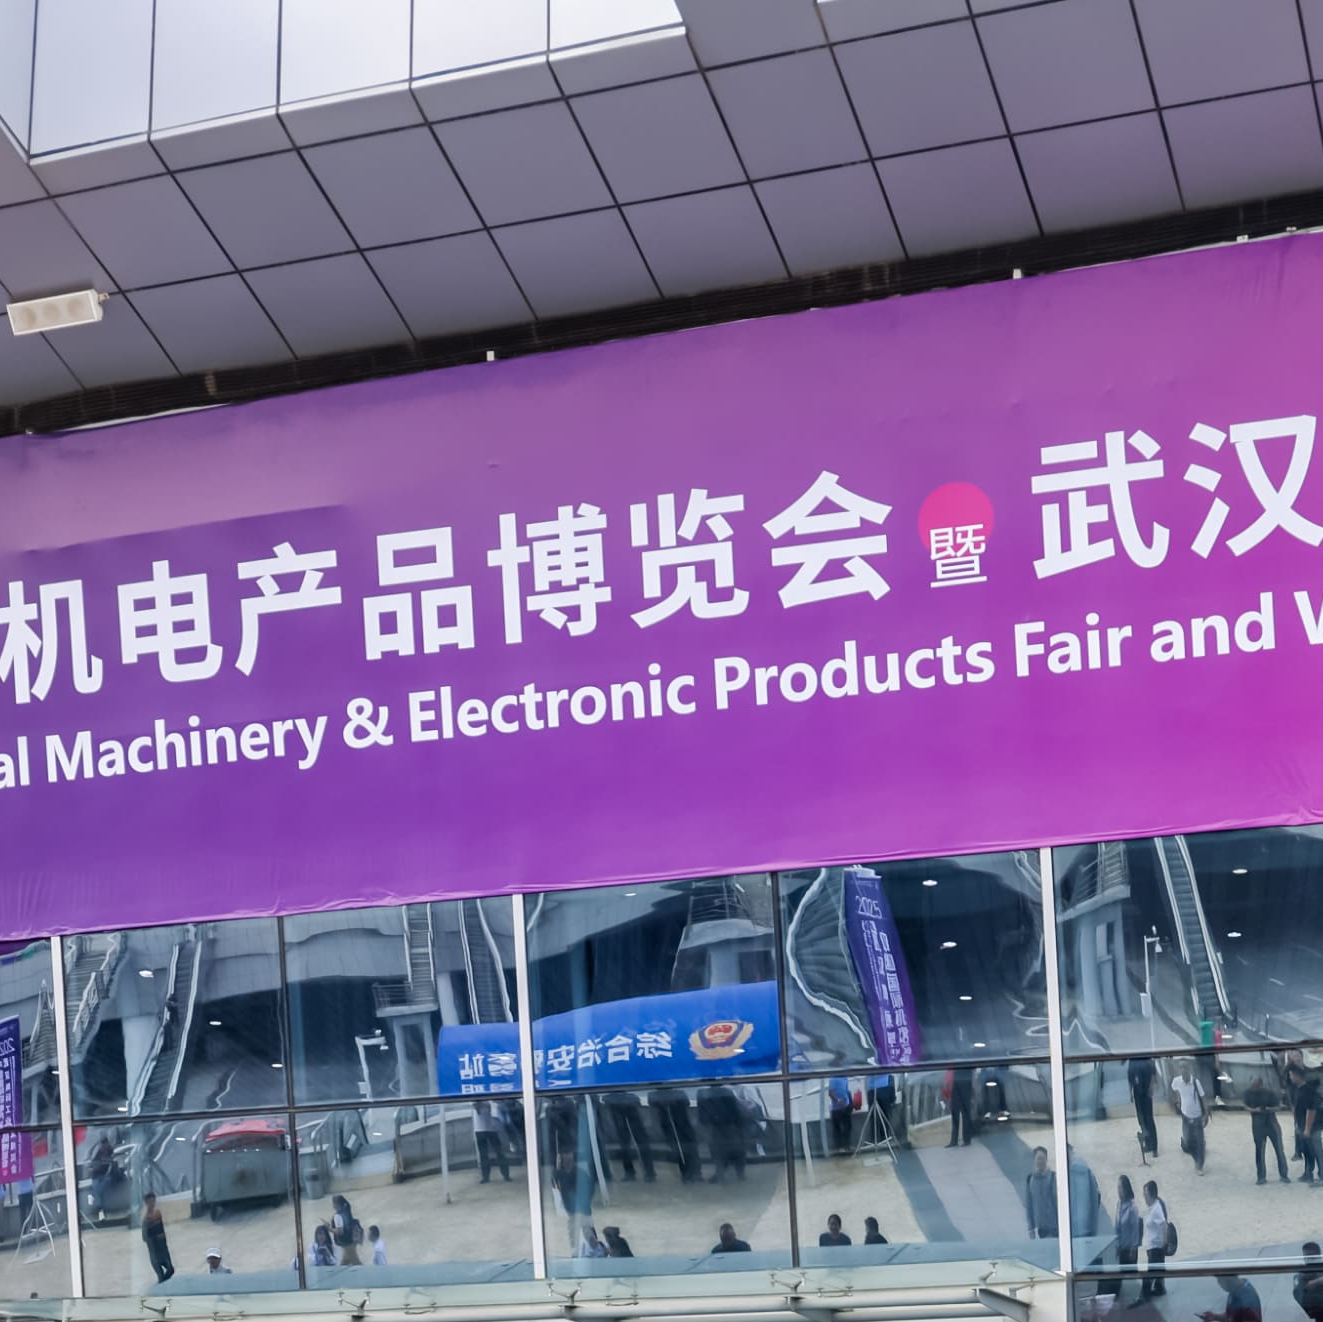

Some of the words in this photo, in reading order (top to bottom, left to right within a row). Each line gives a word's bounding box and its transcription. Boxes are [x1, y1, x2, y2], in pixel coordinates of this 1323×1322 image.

[929, 523, 988, 589] 暨
[45, 714, 328, 783] Machinery
[342, 697, 394, 749] &
[408, 663, 696, 742] Electronic
[714, 635, 995, 710] Products
[1014, 612, 1133, 677] Fair
[1150, 591, 1276, 662] and
